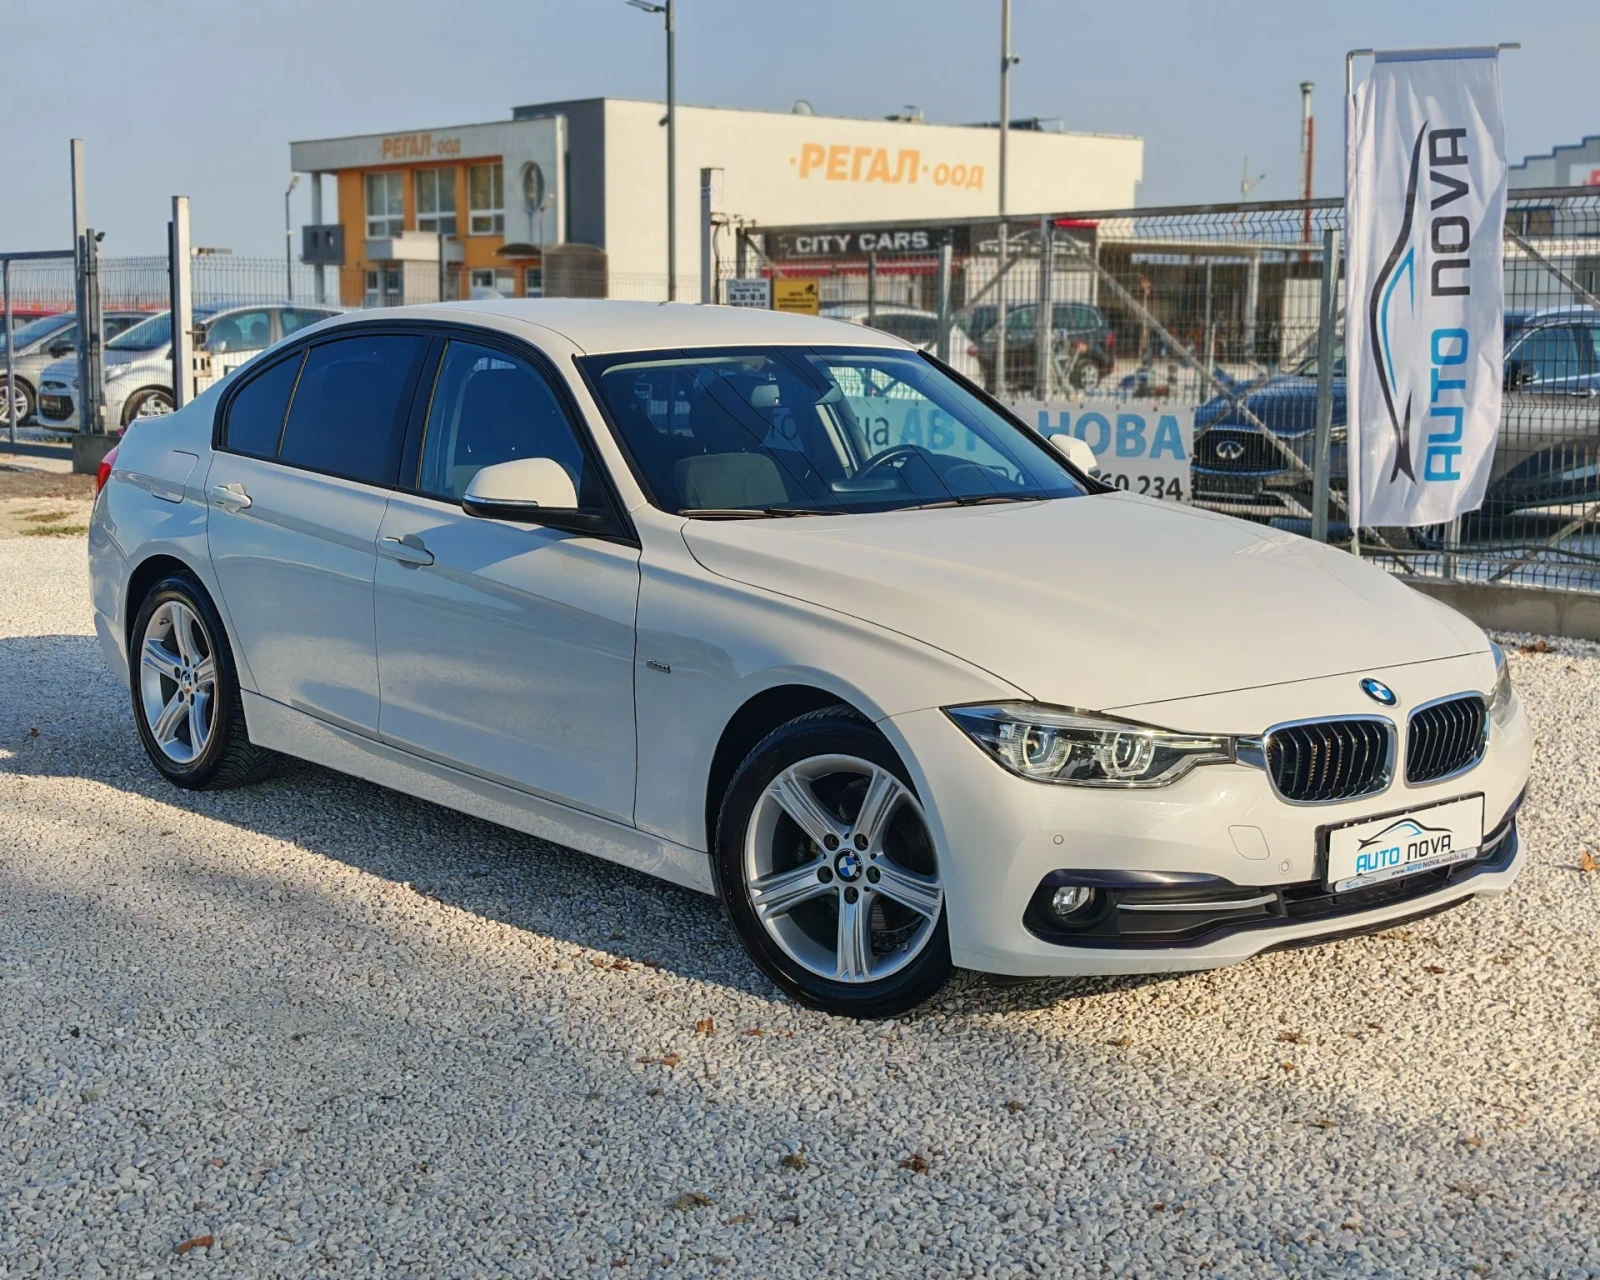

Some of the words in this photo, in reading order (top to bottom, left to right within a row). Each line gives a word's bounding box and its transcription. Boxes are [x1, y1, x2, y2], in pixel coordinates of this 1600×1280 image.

[799, 142, 920, 185] РЕГАЛ
[1429, 127, 1470, 297] NOVA
[795, 234, 852, 254] CITY
[859, 230, 930, 252] CARS
[1424, 328, 1469, 483] AUTO
[1037, 409, 1187, 461] НОВА
[1137, 475, 1184, 502] 234
[1356, 846, 1400, 873] AUTO
[1407, 834, 1451, 861] NOVA
